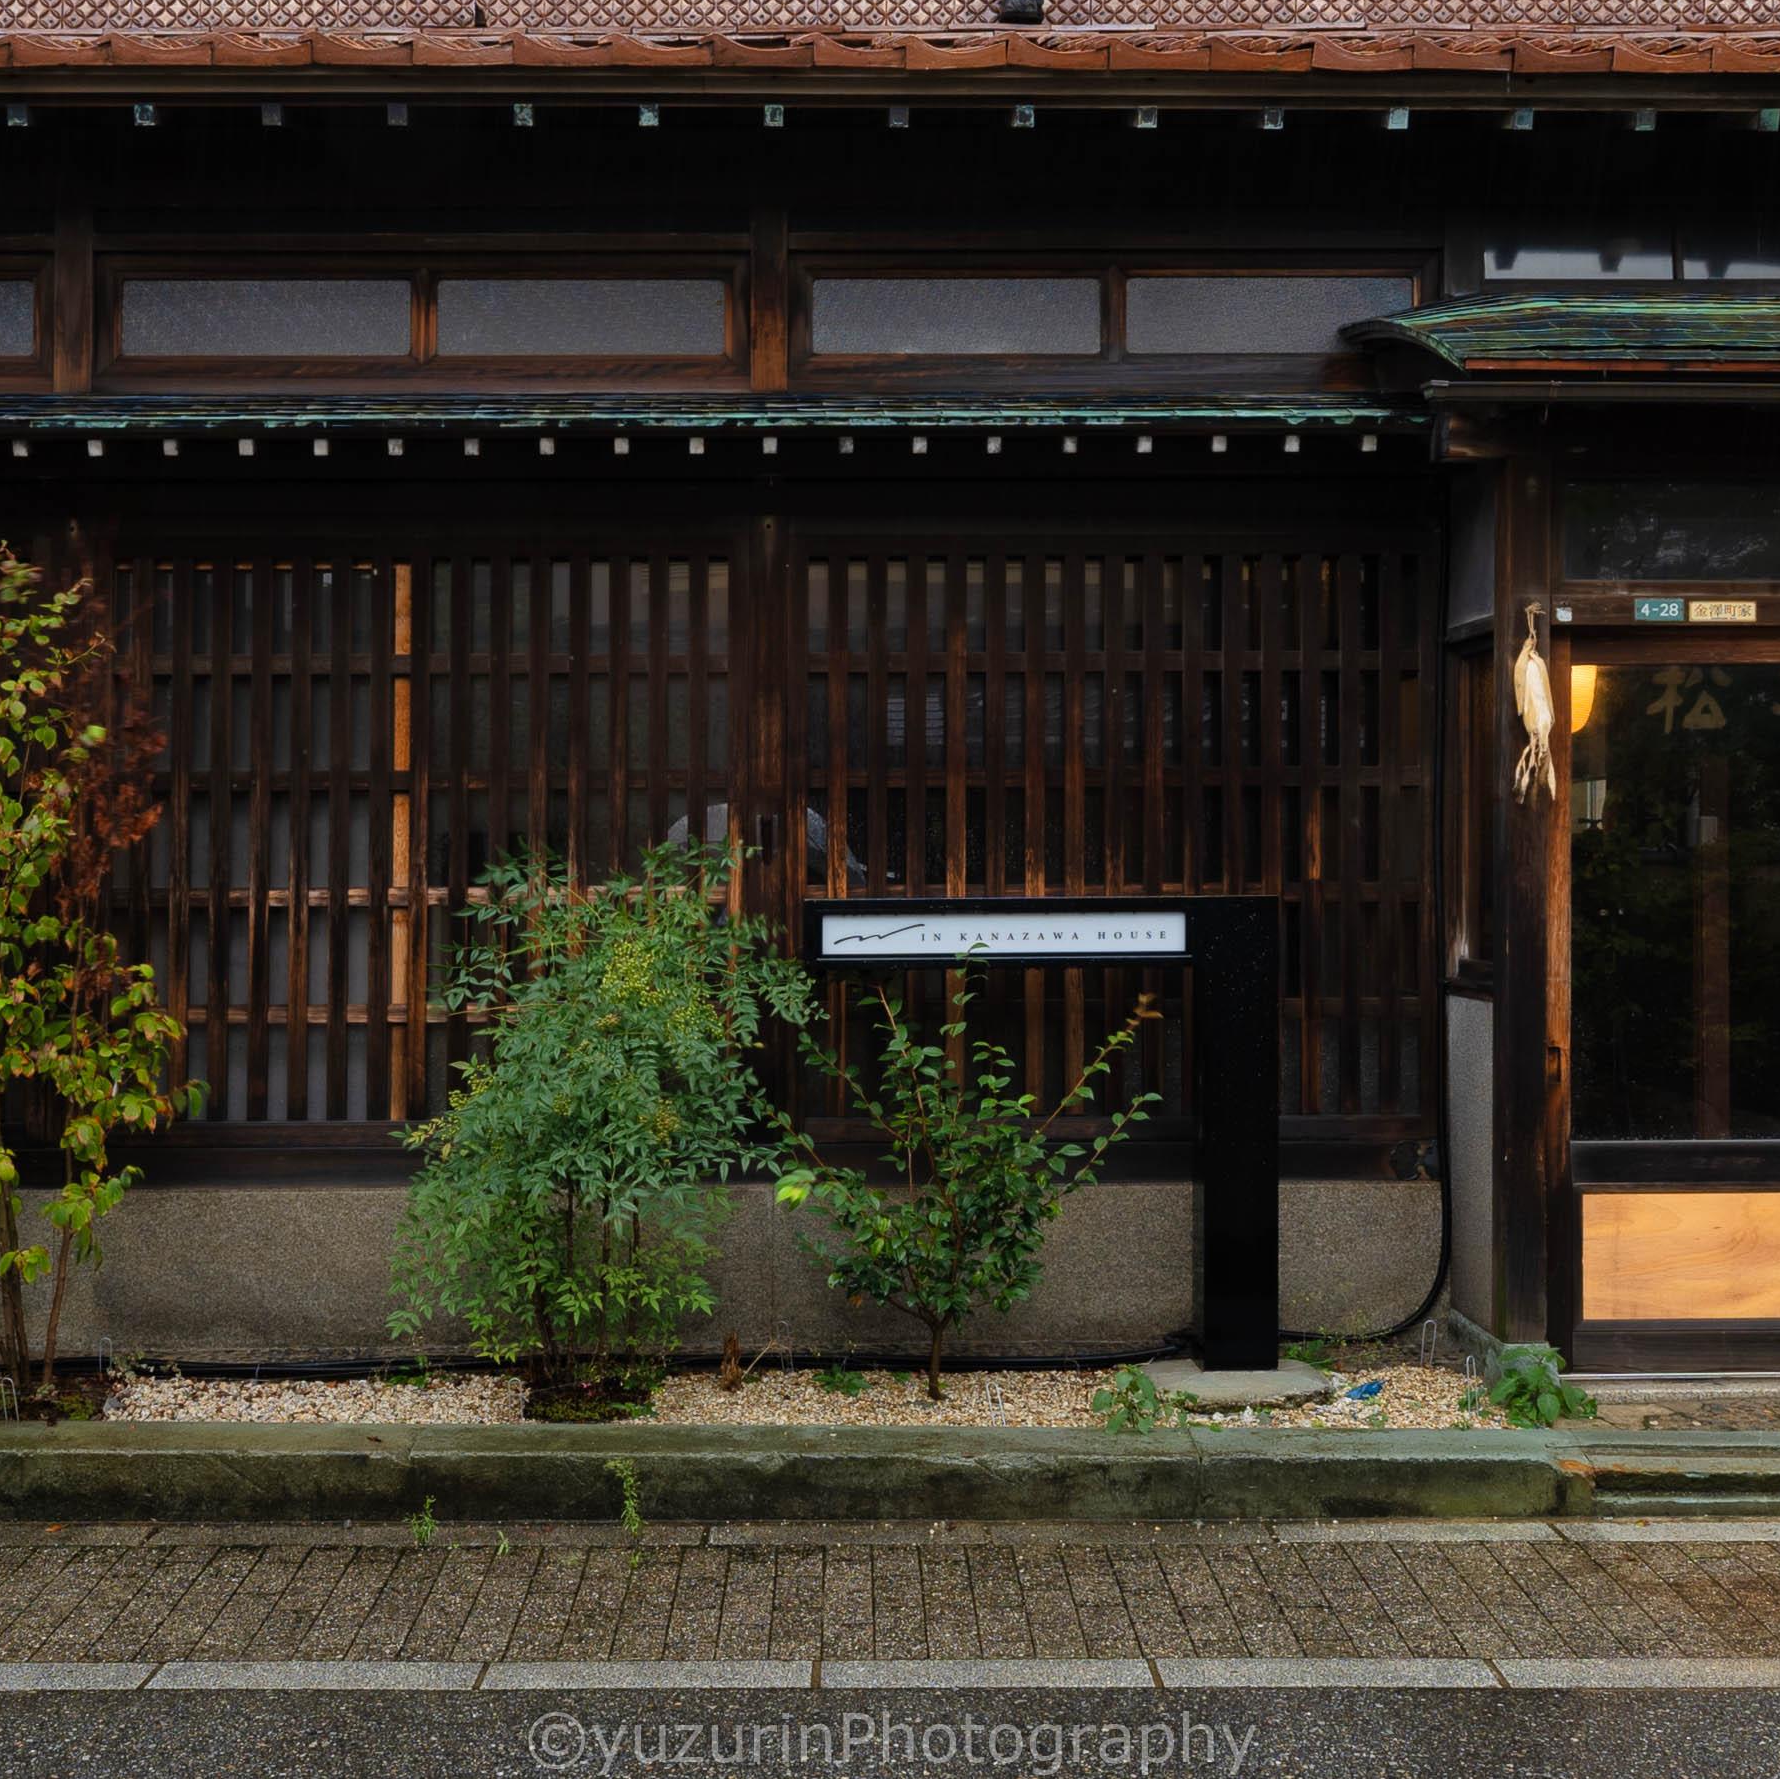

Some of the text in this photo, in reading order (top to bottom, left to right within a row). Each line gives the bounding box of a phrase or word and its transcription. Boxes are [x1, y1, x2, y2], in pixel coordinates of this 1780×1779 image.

[1640, 603, 1679, 617] 4-28
[921, 930, 1167, 942] IN KANAZAWA HOUSE
